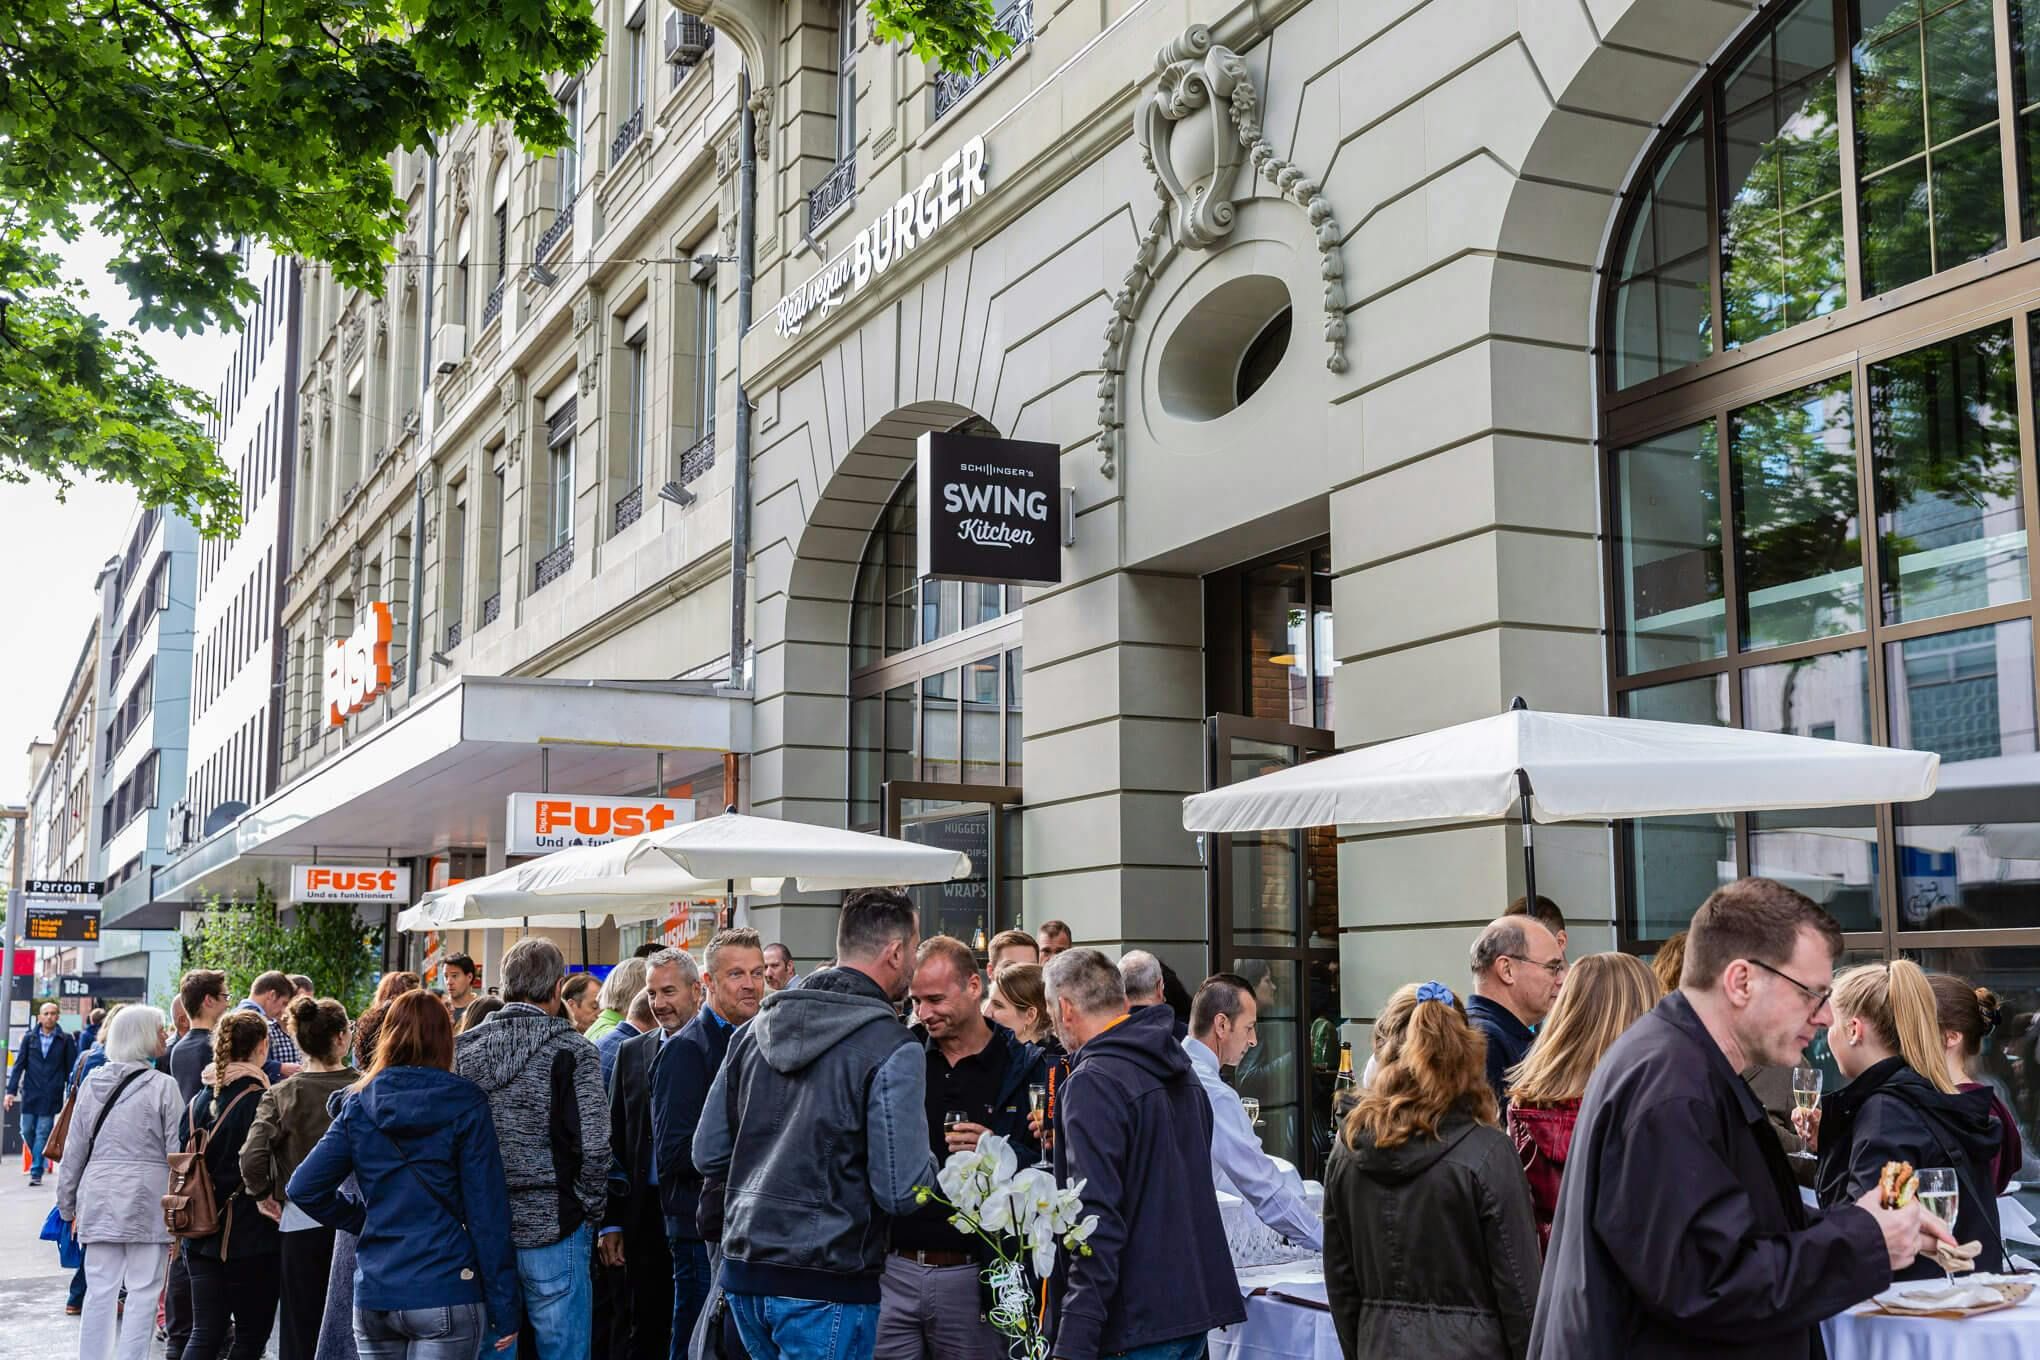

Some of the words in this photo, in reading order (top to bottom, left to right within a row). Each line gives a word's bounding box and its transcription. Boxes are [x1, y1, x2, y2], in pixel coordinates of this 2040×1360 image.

[775, 278, 809, 339] Real
[808, 257, 852, 319] vegan
[853, 134, 986, 292] BURGER
[943, 482, 1048, 521] SWING
[957, 518, 1036, 549] Kitchen
[536, 800, 674, 836] Fust
[944, 823, 987, 834] NUGGETS
[536, 836, 564, 847] Und
[33, 881, 82, 893] Perron
[87, 882, 96, 893] F
[307, 869, 397, 891] Fust
[943, 883, 987, 898] WRAPS
